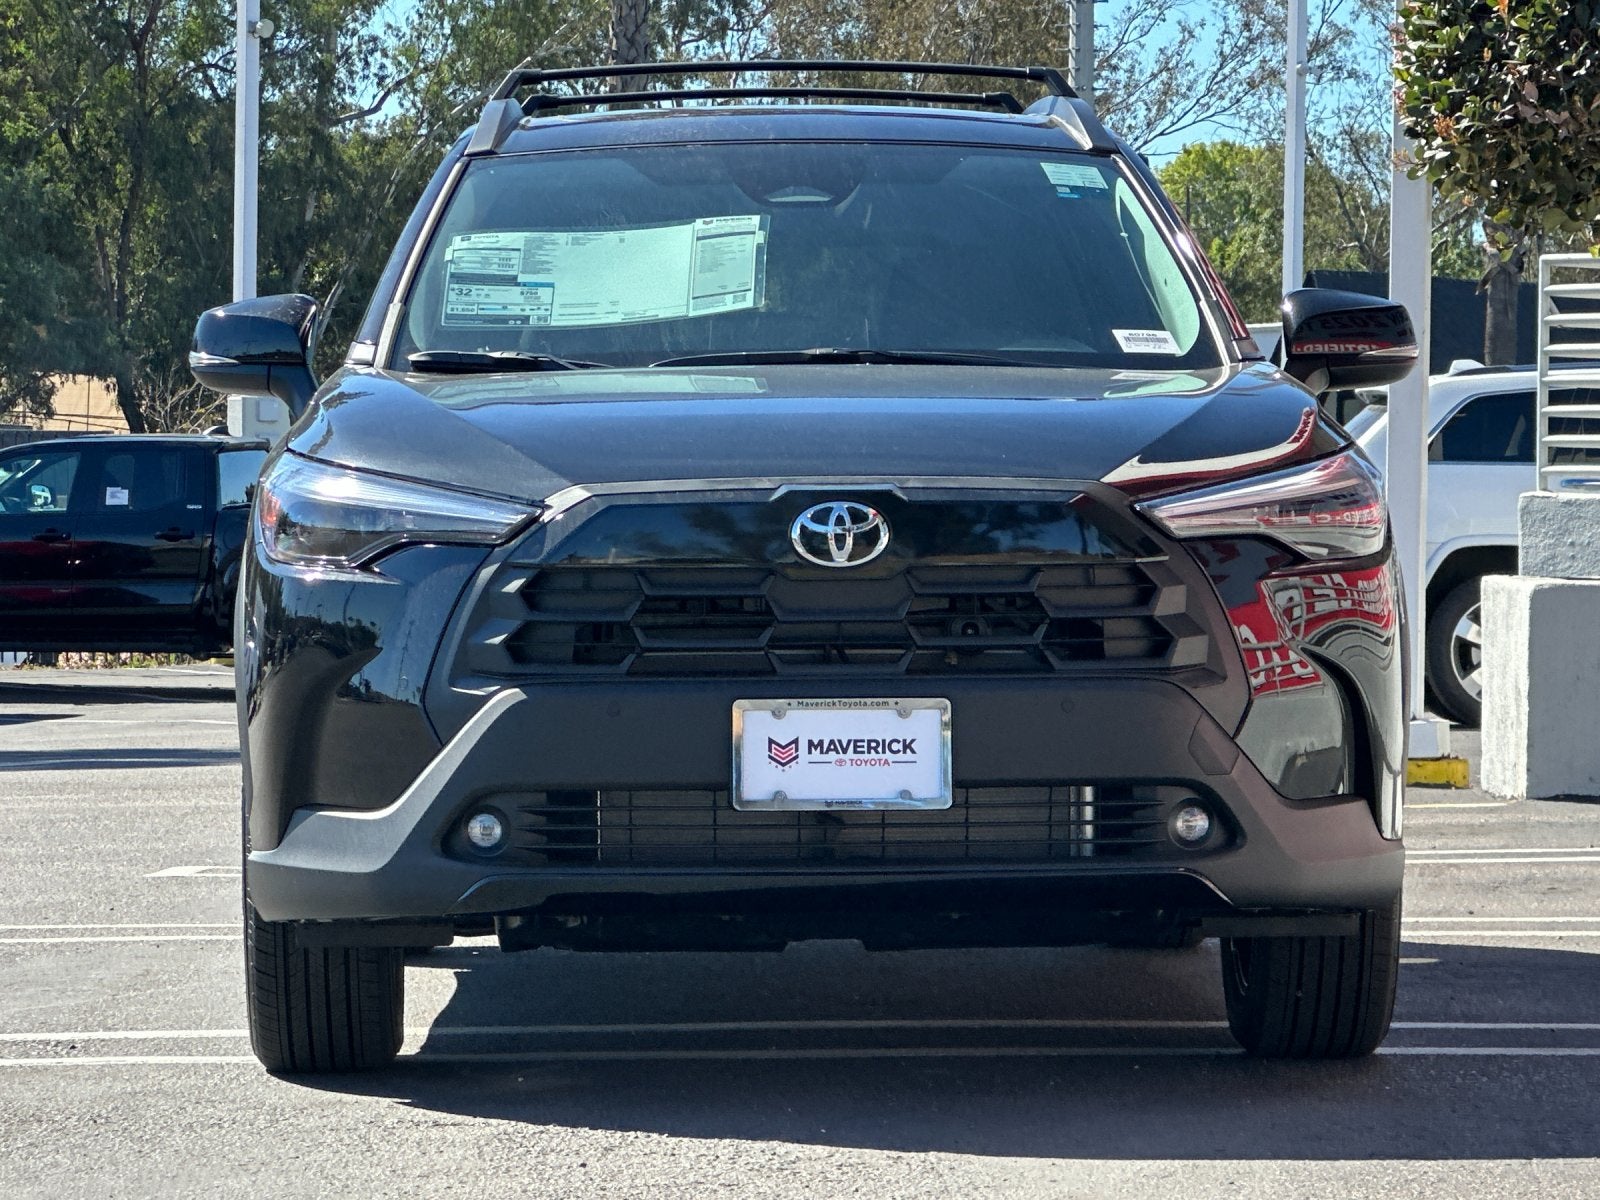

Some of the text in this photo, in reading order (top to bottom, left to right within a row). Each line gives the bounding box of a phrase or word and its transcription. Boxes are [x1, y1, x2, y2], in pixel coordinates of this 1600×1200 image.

[455, 287, 473, 297] 32
[797, 700, 890, 708] MaverickToyota.com
[807, 738, 917, 755] MAVERICK
[849, 758, 891, 767] TOYOTA
